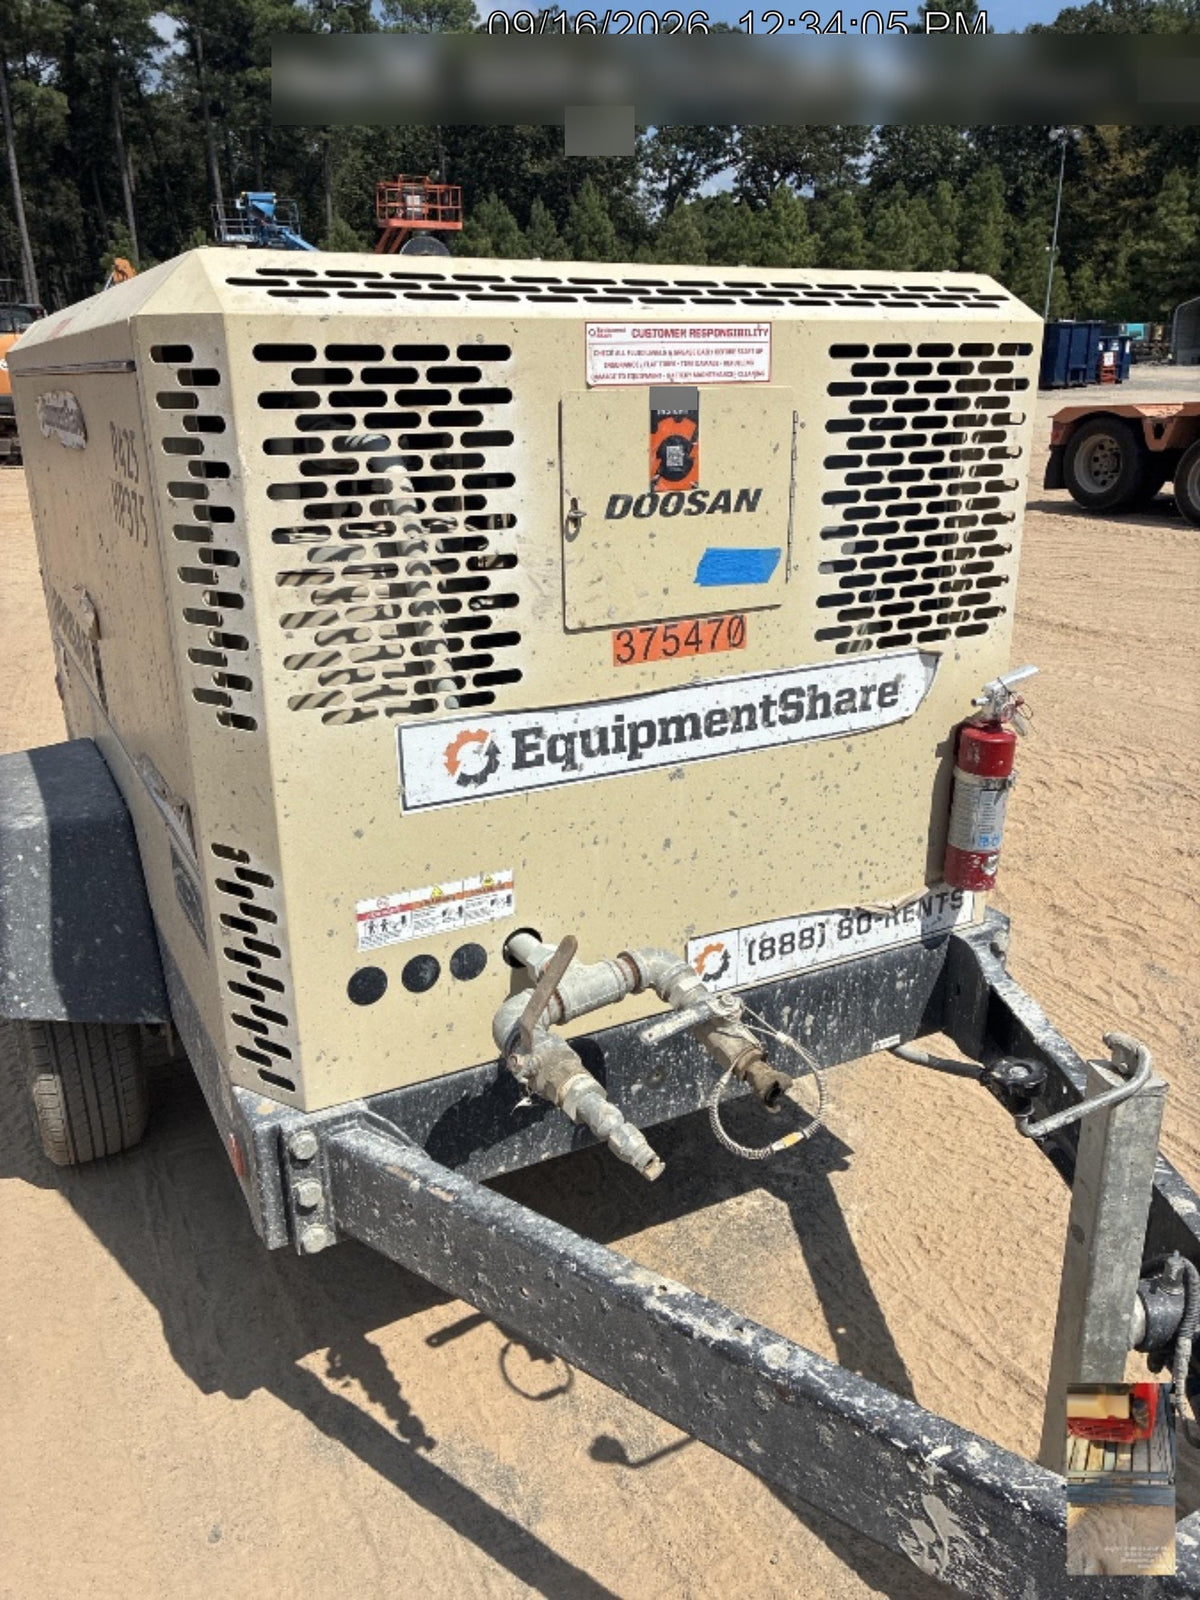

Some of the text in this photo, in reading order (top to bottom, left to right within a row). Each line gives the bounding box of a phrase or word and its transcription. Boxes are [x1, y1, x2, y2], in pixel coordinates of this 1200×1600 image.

[631, 328, 687, 338] CUSTOMER
[689, 327, 769, 338] RESPONSIBILITY
[604, 488, 763, 520] DOOSAN
[615, 614, 746, 664] 375470
[511, 675, 902, 772] EquipmentShare
[748, 922, 827, 967] (888)
